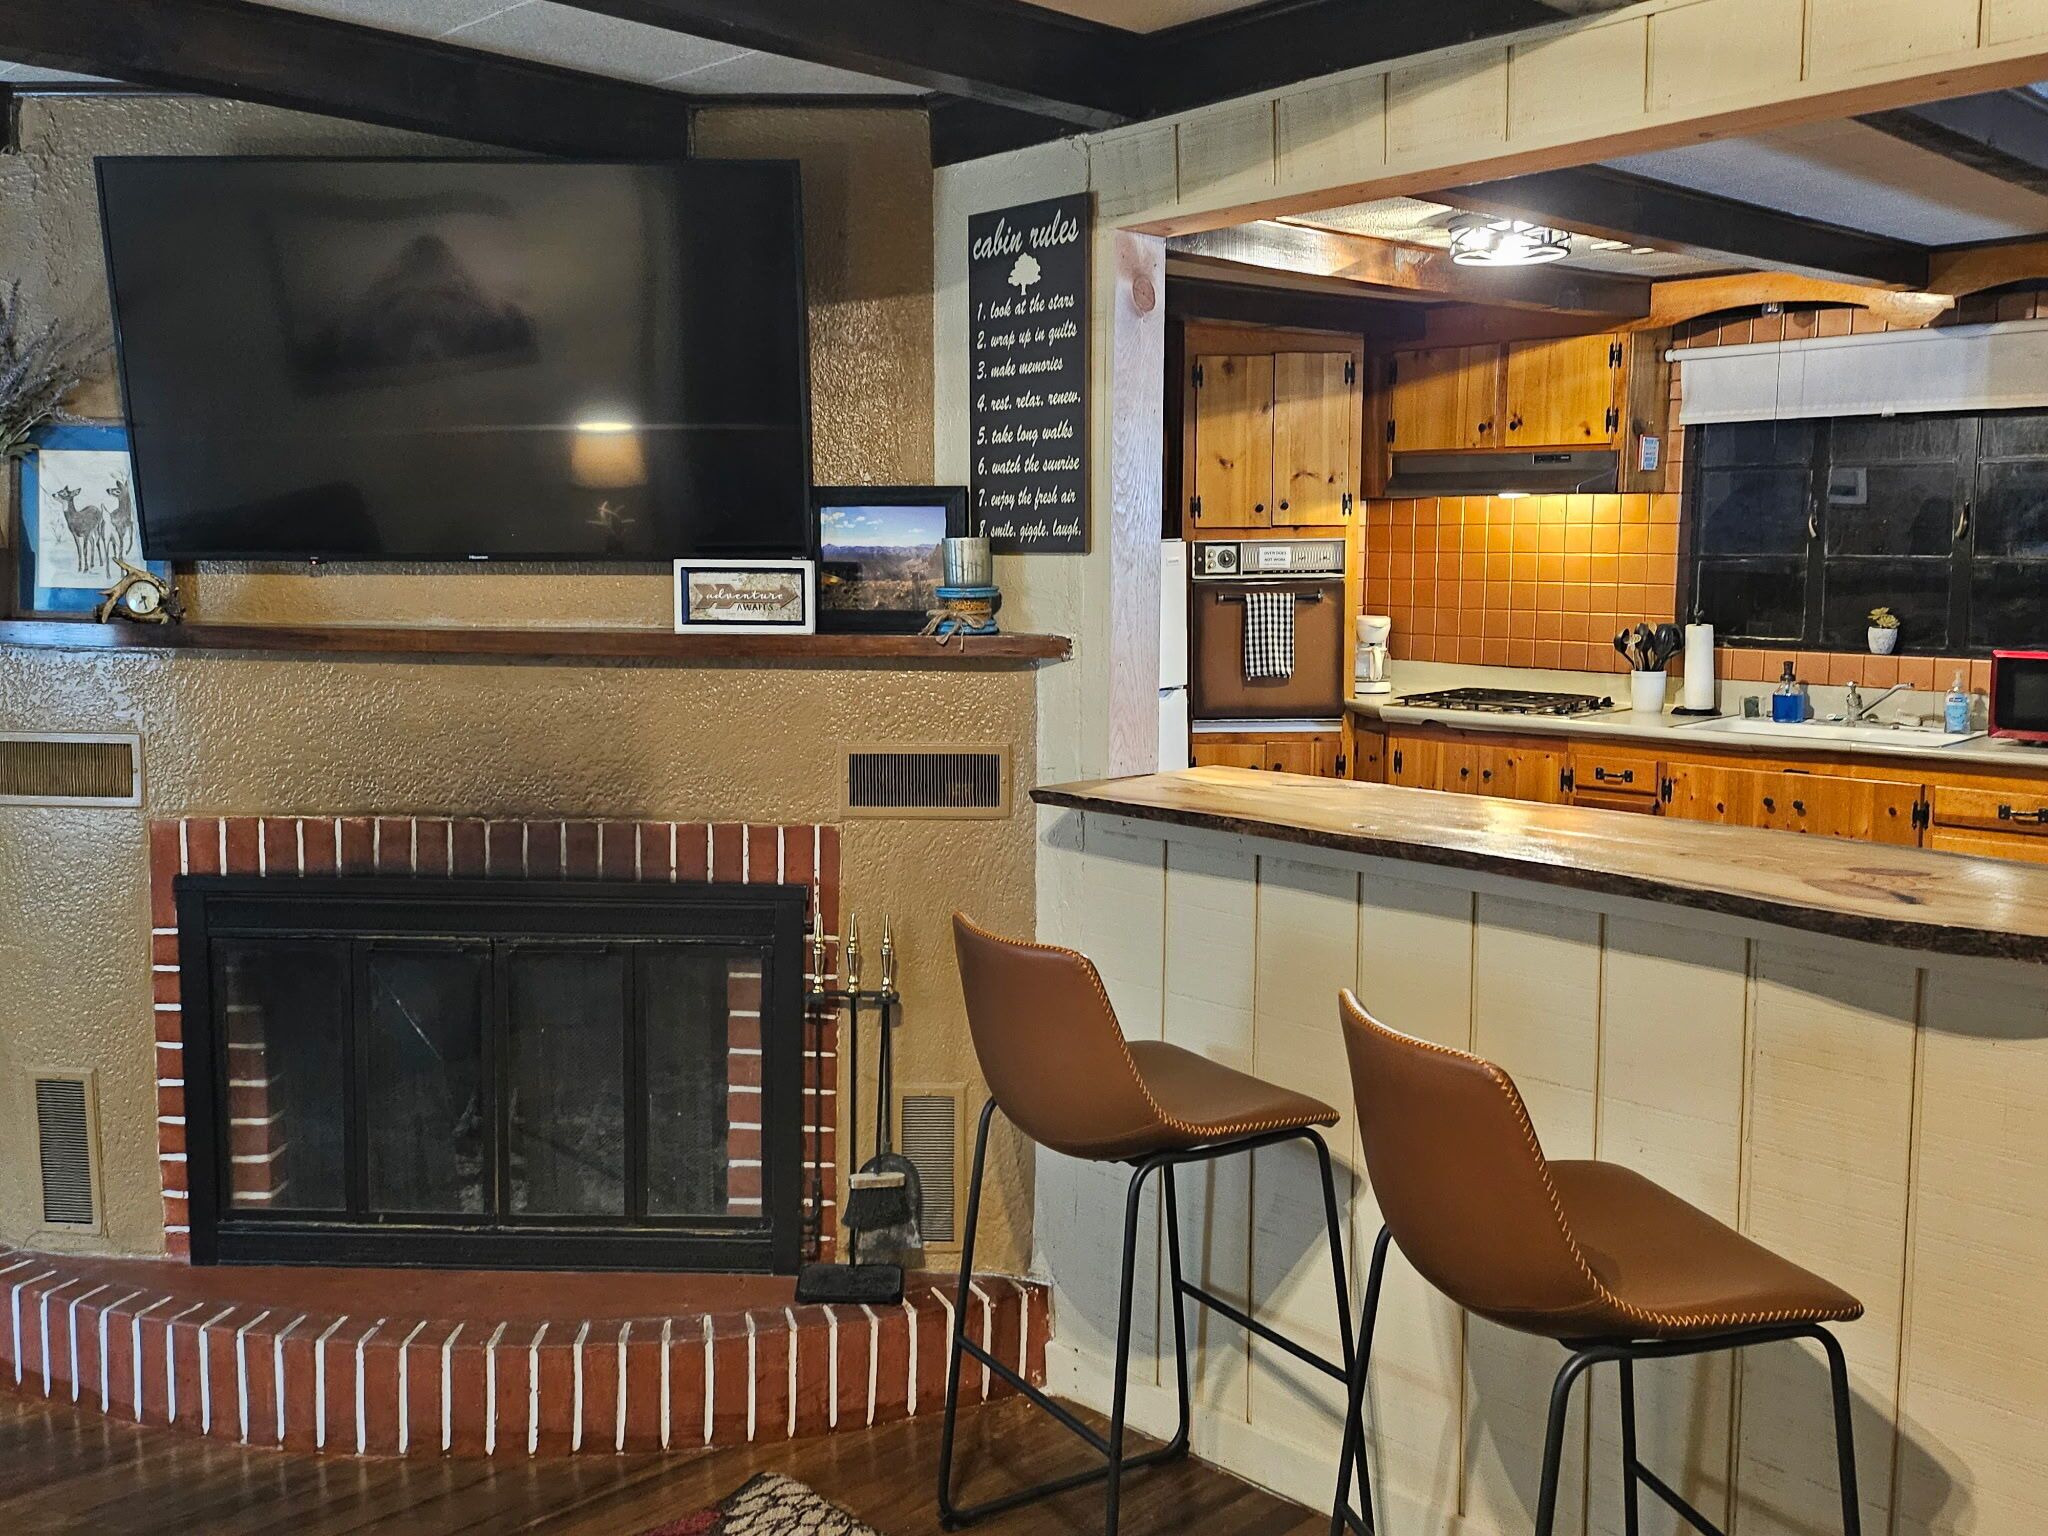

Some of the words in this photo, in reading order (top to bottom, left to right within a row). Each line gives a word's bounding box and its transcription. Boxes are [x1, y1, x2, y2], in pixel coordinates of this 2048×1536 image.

[973, 217, 1023, 260] cabin
[1029, 208, 1079, 249] rules
[977, 302, 986, 321] 1.
[990, 297, 1012, 319] look
[1014, 299, 1027, 315] at
[1029, 293, 1045, 313] the
[1048, 293, 1075, 310] stars
[976, 330, 987, 349] 2.
[990, 330, 1016, 350] wrap
[1018, 328, 1032, 348] up
[1034, 326, 1046, 342] in
[1048, 318, 1078, 346] quilts
[976, 360, 987, 379] 3.
[990, 357, 1016, 378] make
[1018, 356, 1064, 375] memories
[976, 393, 987, 412] 4.
[976, 425, 988, 445] 5.
[991, 424, 1014, 445] take
[1016, 423, 1039, 448] long
[1041, 418, 1074, 440] walks
[977, 456, 988, 476] 6.
[991, 453, 1021, 475] watch
[1023, 452, 1040, 474] the
[1042, 454, 1080, 472] sunrise
[978, 488, 988, 508] 7.
[990, 490, 1016, 511] enjoy
[1017, 485, 1032, 506] the
[1033, 484, 1058, 511] fresh
[1060, 487, 1077, 504] air
[978, 519, 988, 538] 8.
[706, 588, 784, 600] adventure
